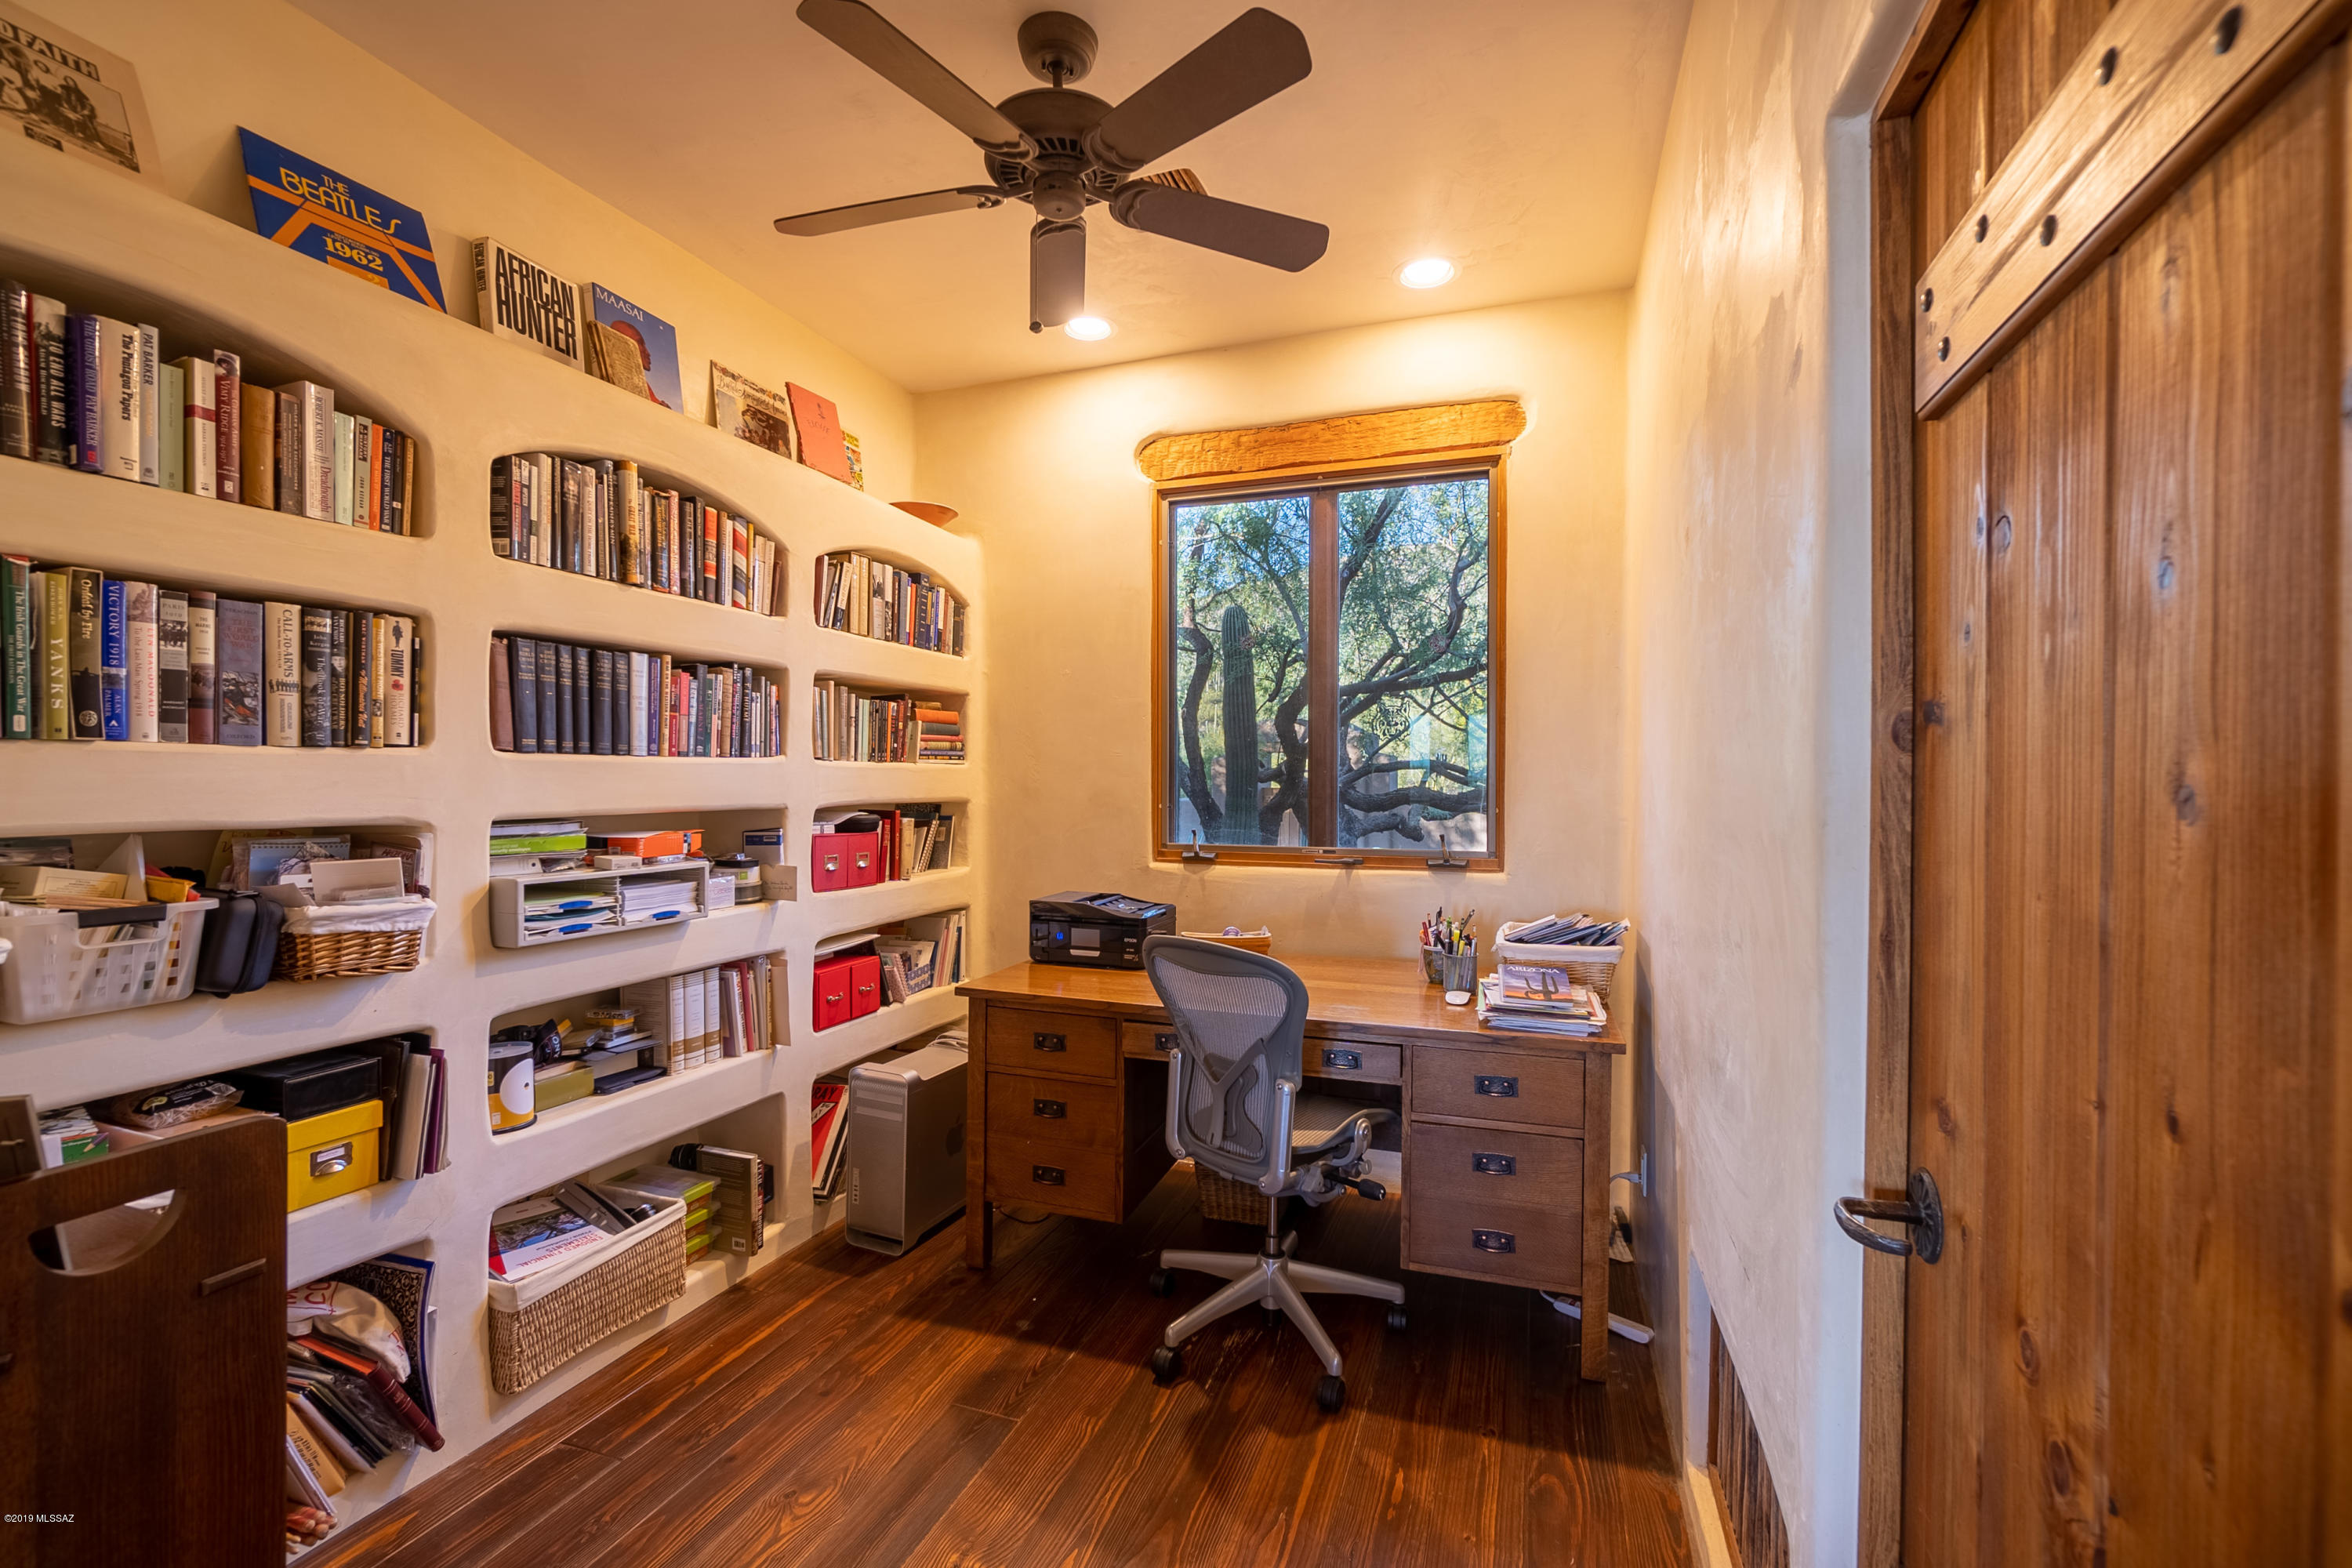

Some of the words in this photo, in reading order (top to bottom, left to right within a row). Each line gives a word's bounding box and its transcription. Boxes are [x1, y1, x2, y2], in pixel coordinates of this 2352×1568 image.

[17, 28, 99, 80] FAITH
[321, 174, 350, 197] THE
[279, 166, 401, 234] BEATLES
[322, 236, 383, 272] 1962
[474, 242, 485, 269] AFRICAN
[476, 268, 487, 293] HUNTER
[495, 245, 575, 321] AFRICAN
[595, 287, 644, 322] MAASAI
[85, 320, 96, 337] THE
[496, 281, 579, 361] HUNTER
[49, 340, 64, 357] TO
[122, 333, 134, 349] The
[143, 332, 153, 347] PAT
[85, 338, 96, 368] GHOST
[50, 356, 64, 376] END
[119, 352, 133, 390] Pentagon
[143, 351, 154, 385] BARKER
[50, 377, 65, 397] ALL
[85, 368, 96, 392] ROAD
[220, 380, 230, 401] VIMY
[50, 401, 66, 429] WARS
[85, 394, 97, 412] PAT
[119, 390, 133, 421] Papers
[314, 396, 325, 420] ROBERT
[85, 412, 97, 445] BARKER
[220, 404, 230, 433] RIDGE
[219, 435, 227, 463] 1914-1917
[315, 426, 325, 453] MASSIE
[319, 466, 332, 514] Dreadnought
[16, 590, 25, 605] The
[81, 579, 93, 608] Ordeal
[77, 609, 93, 620] by
[108, 585, 119, 638] VICTORY
[16, 623, 26, 650] Guards
[81, 621, 93, 639] Fire
[135, 628, 142, 637] To
[109, 642, 119, 666] 1918
[390, 648, 404, 678] TOMMY
[16, 660, 26, 674] The
[50, 637, 64, 710] YANKS
[16, 675, 26, 695] Great
[133, 680, 142, 699] Spring
[147, 651, 155, 717] MACDONALD
[318, 673, 326, 695] Book
[16, 696, 26, 712] War
[318, 706, 326, 724] War
[545, 1232, 598, 1253] STATEMENTS
[515, 1250, 564, 1267] FINANCIAL
